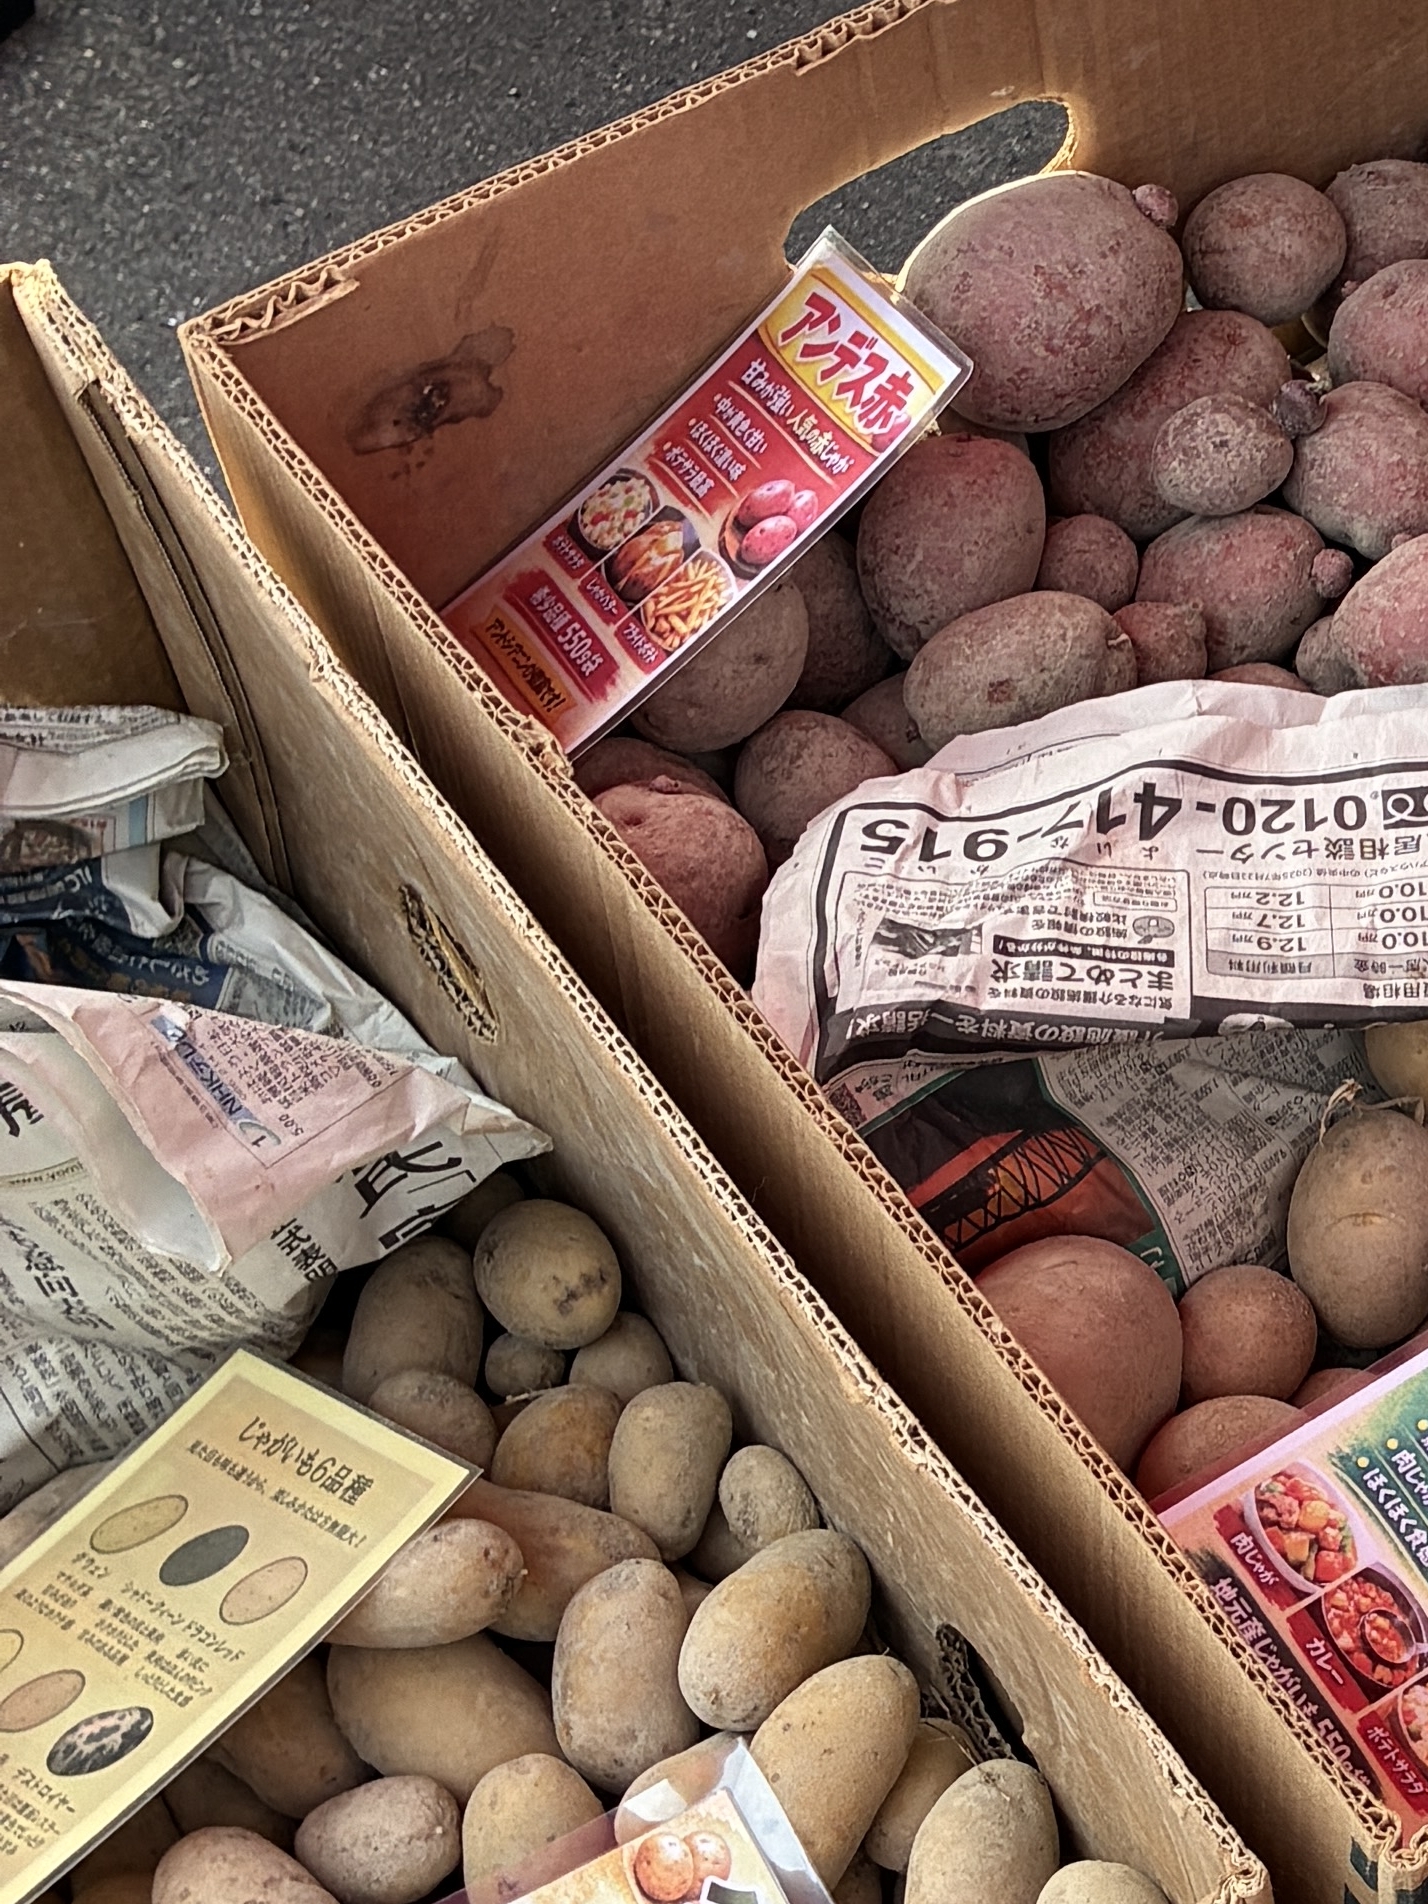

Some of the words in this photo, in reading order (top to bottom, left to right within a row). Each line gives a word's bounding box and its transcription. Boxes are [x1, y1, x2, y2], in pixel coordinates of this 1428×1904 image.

[780, 291, 915, 436] アンデス赤
[715, 397, 768, 455] 中が黄色く甘い
[740, 357, 795, 417] 甘みが強い
[788, 408, 857, 475] 人気の赤じゃが
[665, 447, 715, 497] ポテサラ最高
[693, 421, 745, 481] ほくほく濃い味
[561, 620, 605, 678] 550g袋
[990, 959, 1175, 991] まとめて請求
[236, 1416, 375, 1506] じゃがいも6品種
[1230, 1532, 1280, 1586] 肉じゃが
[1306, 1637, 1345, 1686] カレー
